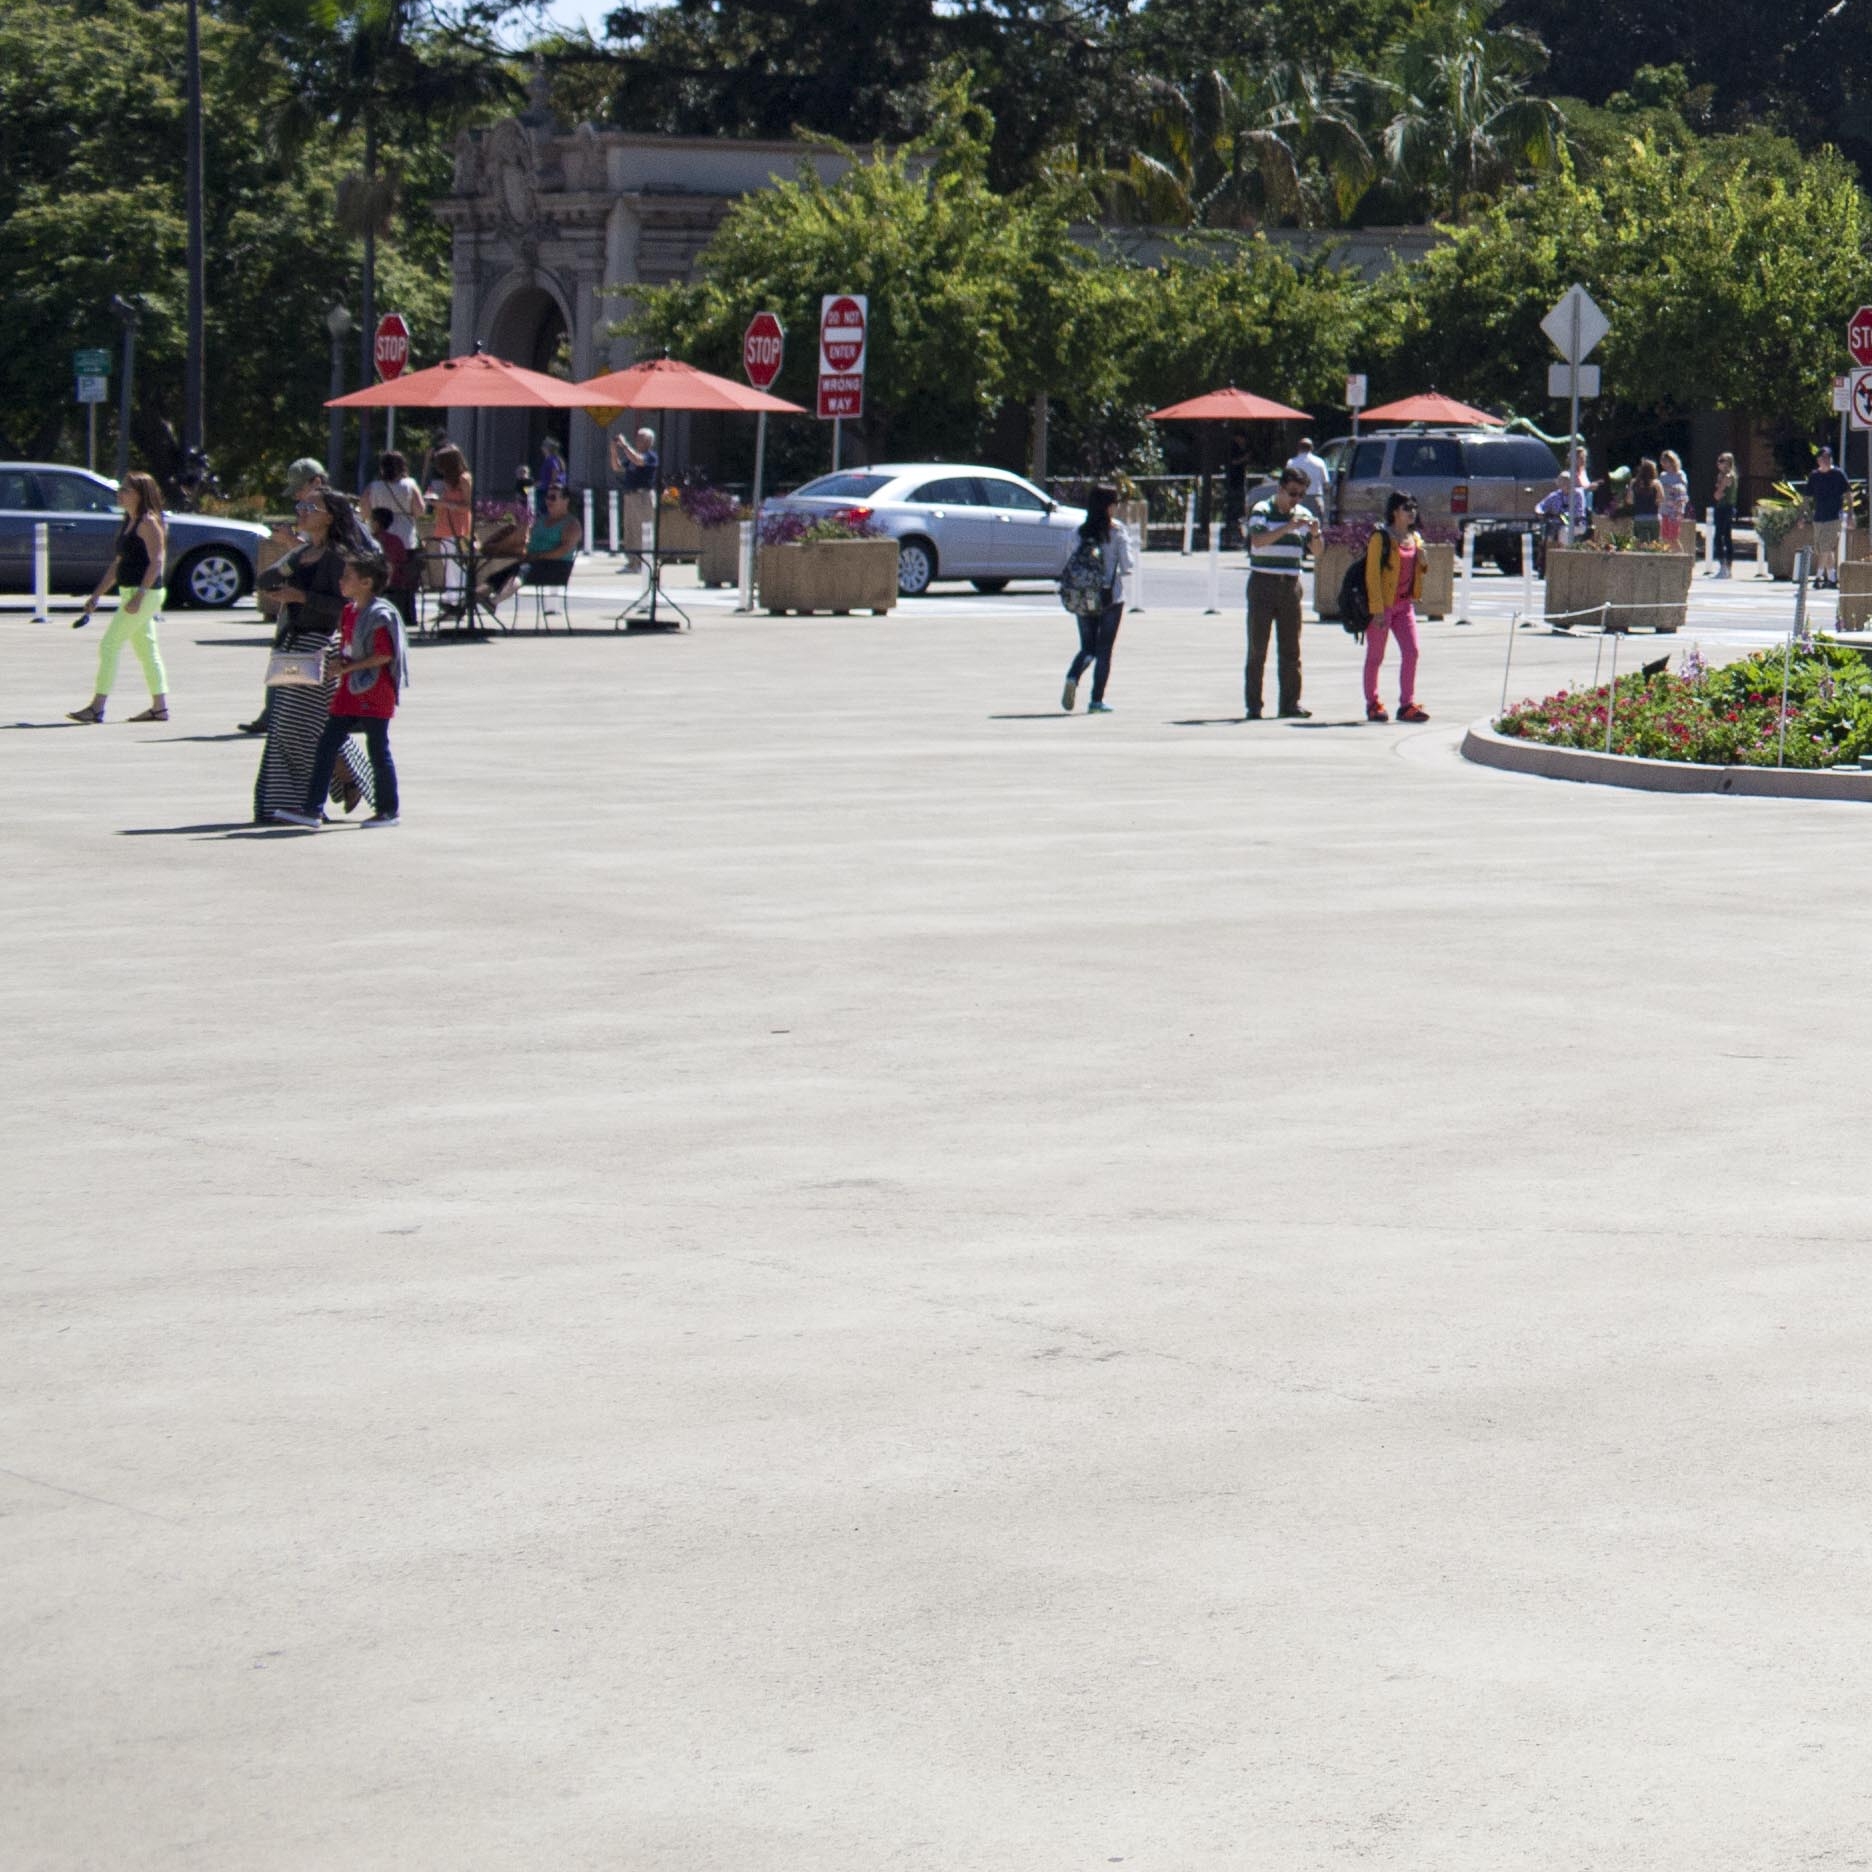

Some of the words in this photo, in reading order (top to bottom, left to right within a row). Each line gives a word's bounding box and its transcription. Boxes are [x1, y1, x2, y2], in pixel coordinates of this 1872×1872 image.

[827, 311, 840, 325] DO
[844, 310, 860, 325] NOT
[377, 335, 406, 361] STOP
[748, 336, 780, 365] STOP
[829, 345, 856, 360] ENTER
[823, 378, 860, 392] WRONG
[828, 397, 853, 412] WAY
